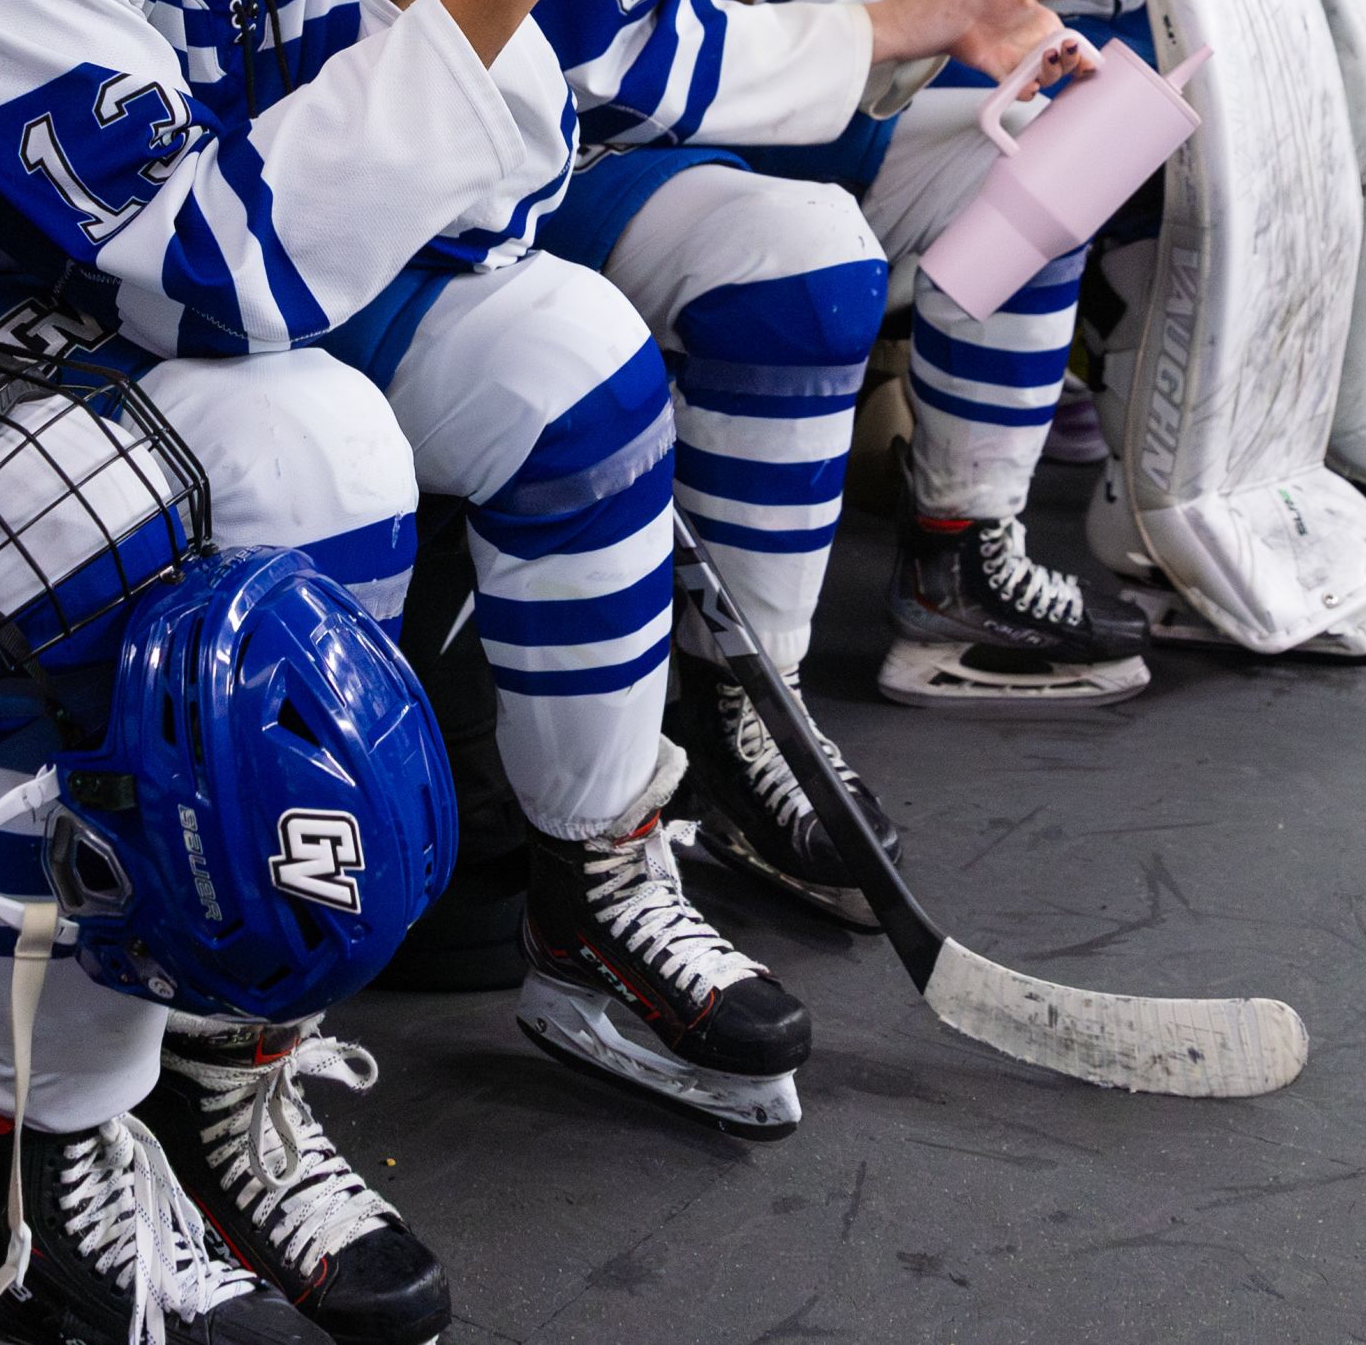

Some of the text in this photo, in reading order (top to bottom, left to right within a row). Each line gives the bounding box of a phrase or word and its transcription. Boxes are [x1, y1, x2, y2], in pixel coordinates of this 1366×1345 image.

[18, 72, 209, 246] 13
[1141, 247, 1199, 495] VAUGHN
[175, 803, 223, 923] BAUER
[270, 808, 367, 914] GV
